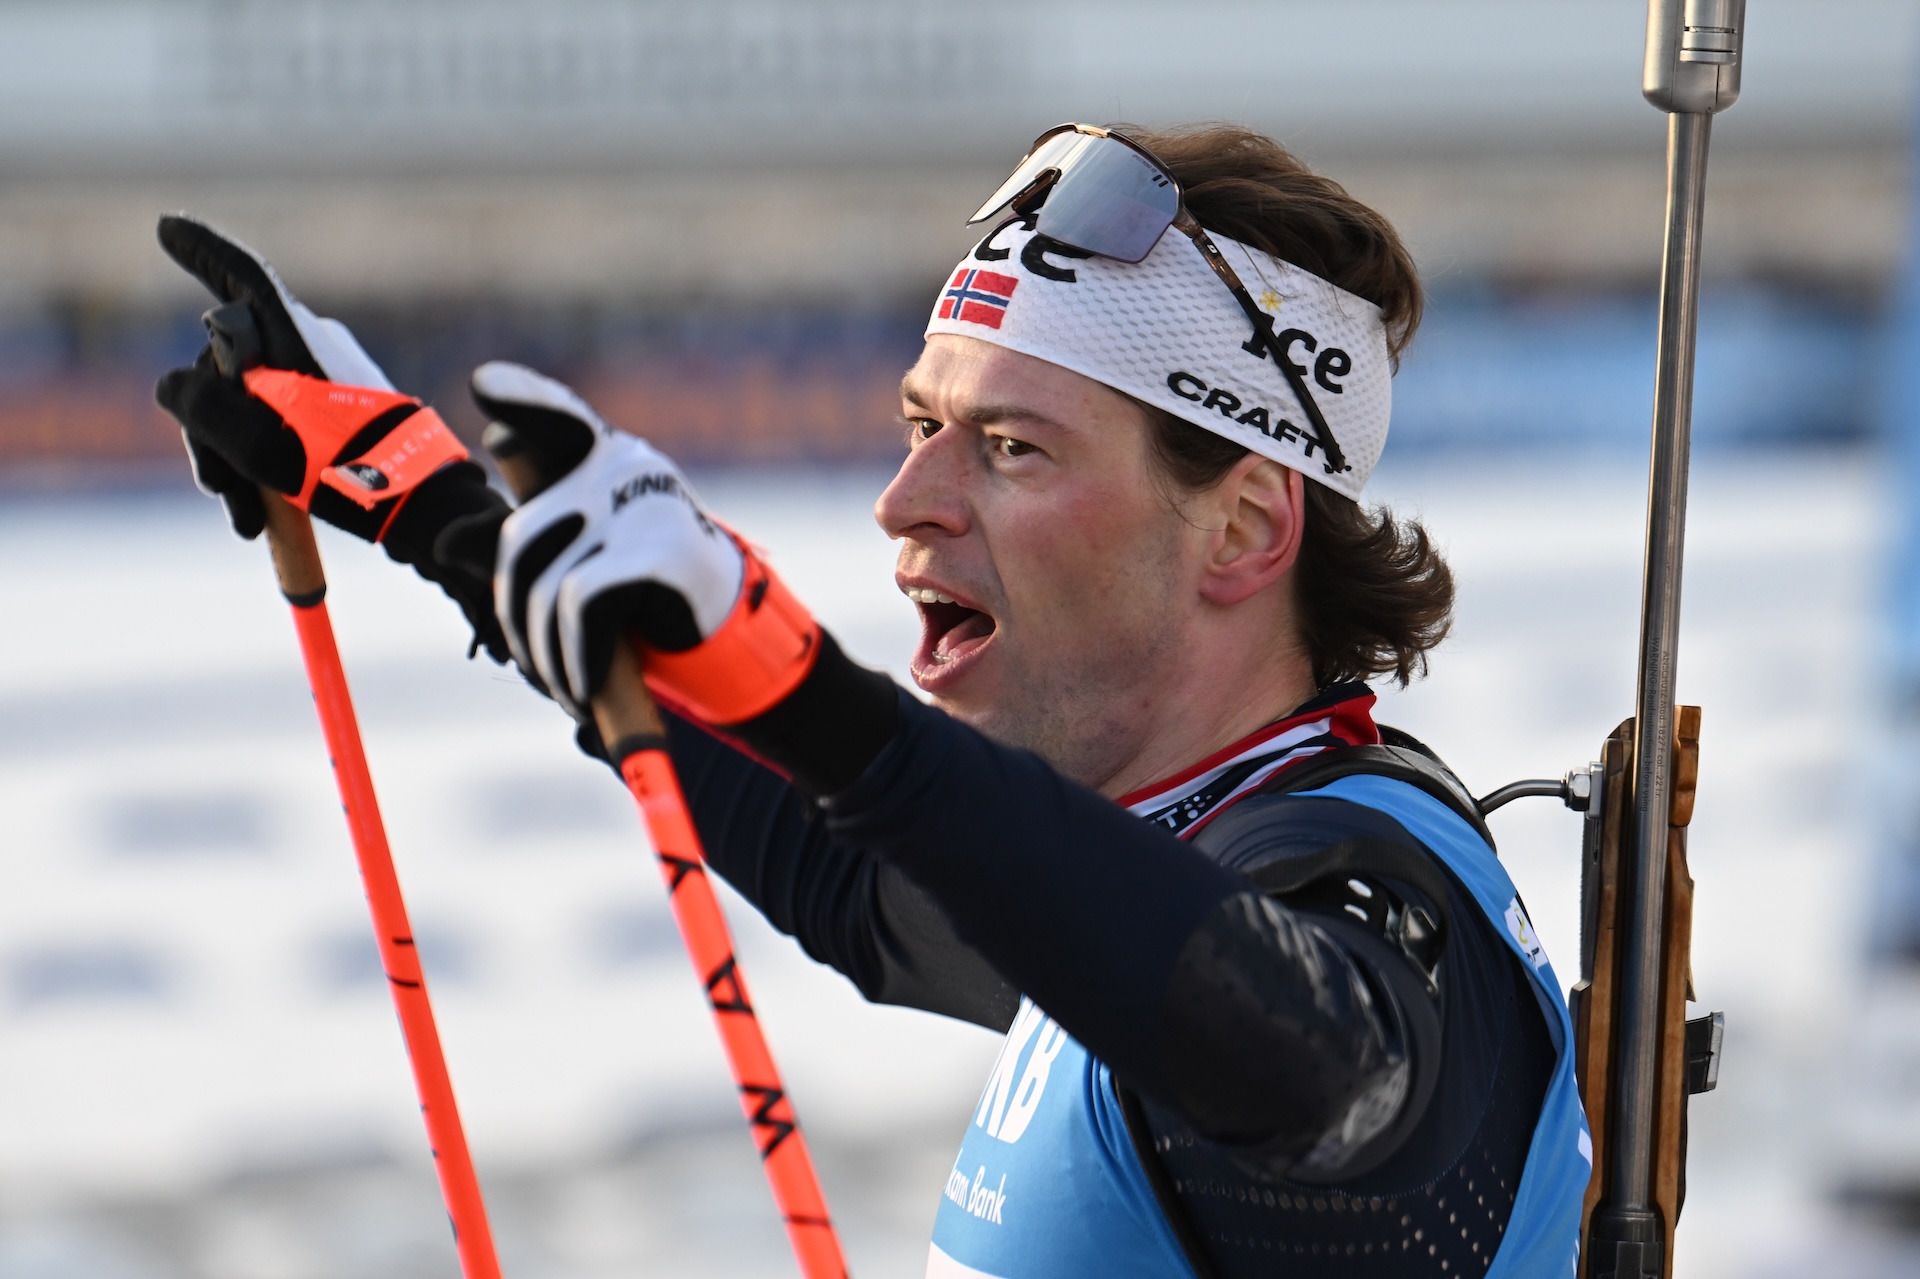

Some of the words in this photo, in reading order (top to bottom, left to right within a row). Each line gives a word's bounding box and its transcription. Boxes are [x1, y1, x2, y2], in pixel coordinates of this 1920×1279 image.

[1167, 371, 1324, 458] CRAFT
[1648, 690, 1656, 711] Read
[1645, 712, 1655, 760] instructions
[1658, 726, 1667, 747] 1827
[1643, 761, 1654, 789] before
[1656, 754, 1664, 769] cal.
[976, 996, 1069, 1144] KB
[966, 1164, 1007, 1225] Bank
